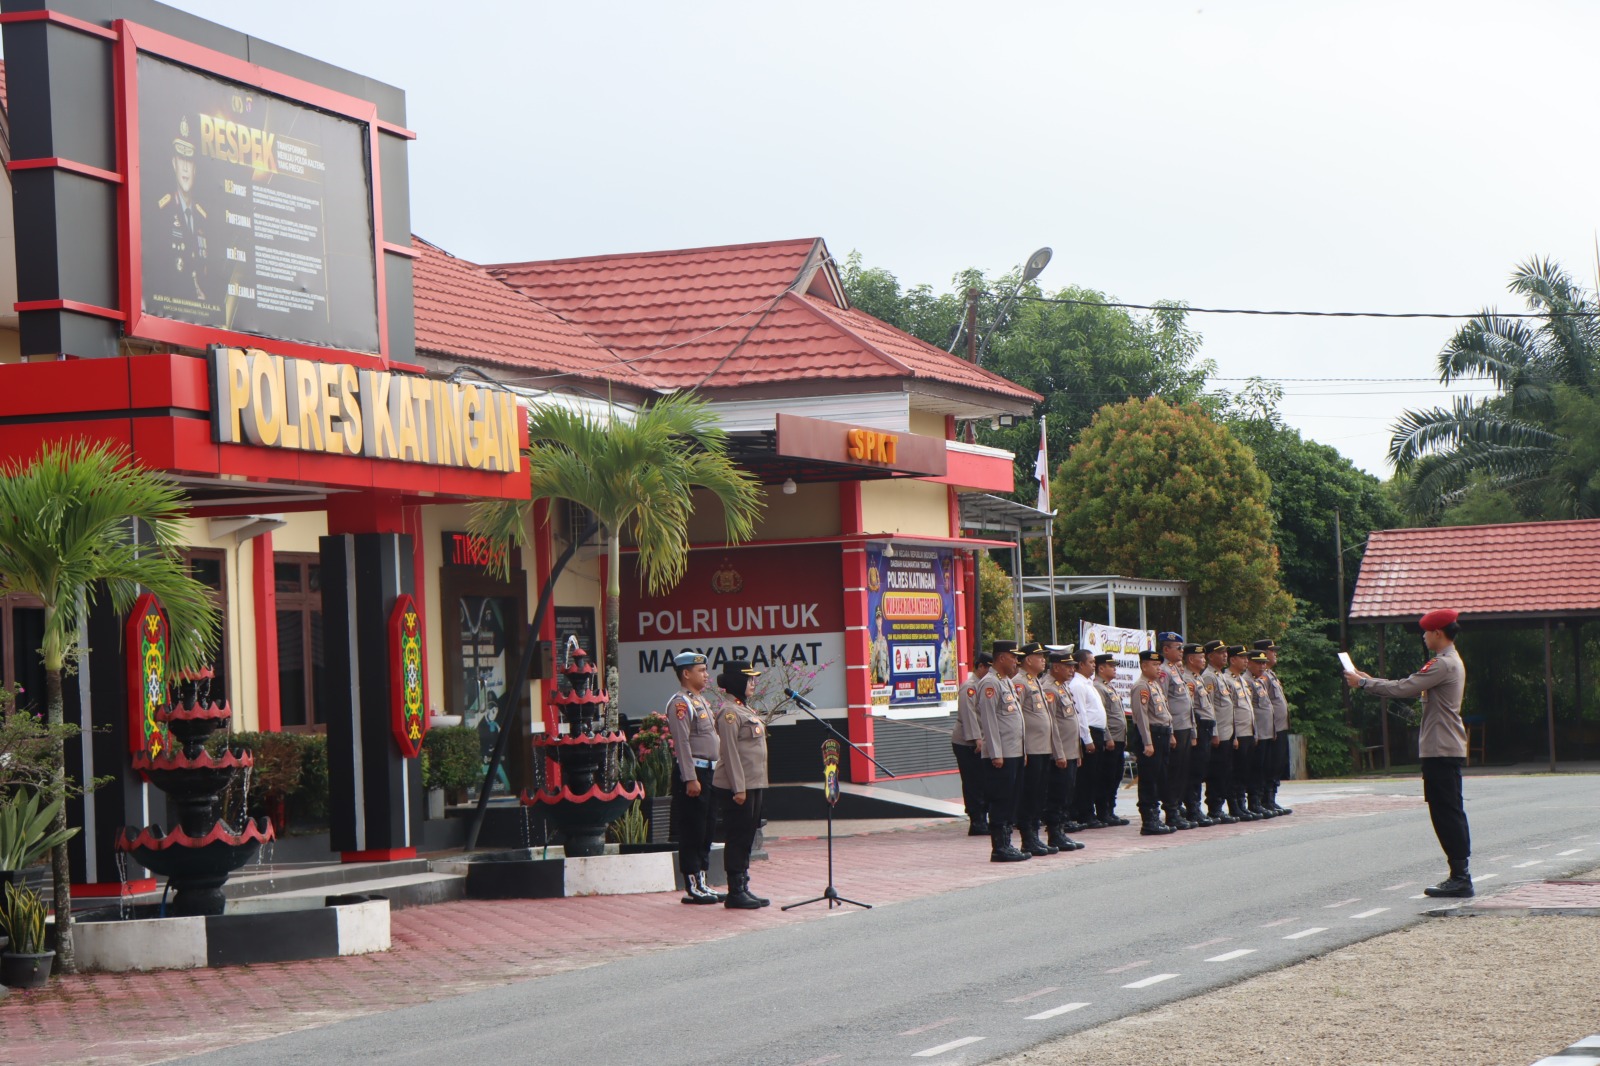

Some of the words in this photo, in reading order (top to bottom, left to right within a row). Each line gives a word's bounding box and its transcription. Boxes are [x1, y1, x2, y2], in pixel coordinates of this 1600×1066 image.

[200, 113, 278, 174] RESPEK
[218, 348, 364, 455] POLRES
[361, 370, 520, 473] KATINGAN
[849, 428, 899, 465] SPKT
[887, 571, 908, 589] POLRES
[908, 572, 936, 590] KATINGAN
[638, 608, 718, 636] POLRI
[726, 603, 820, 632] UNTUK
